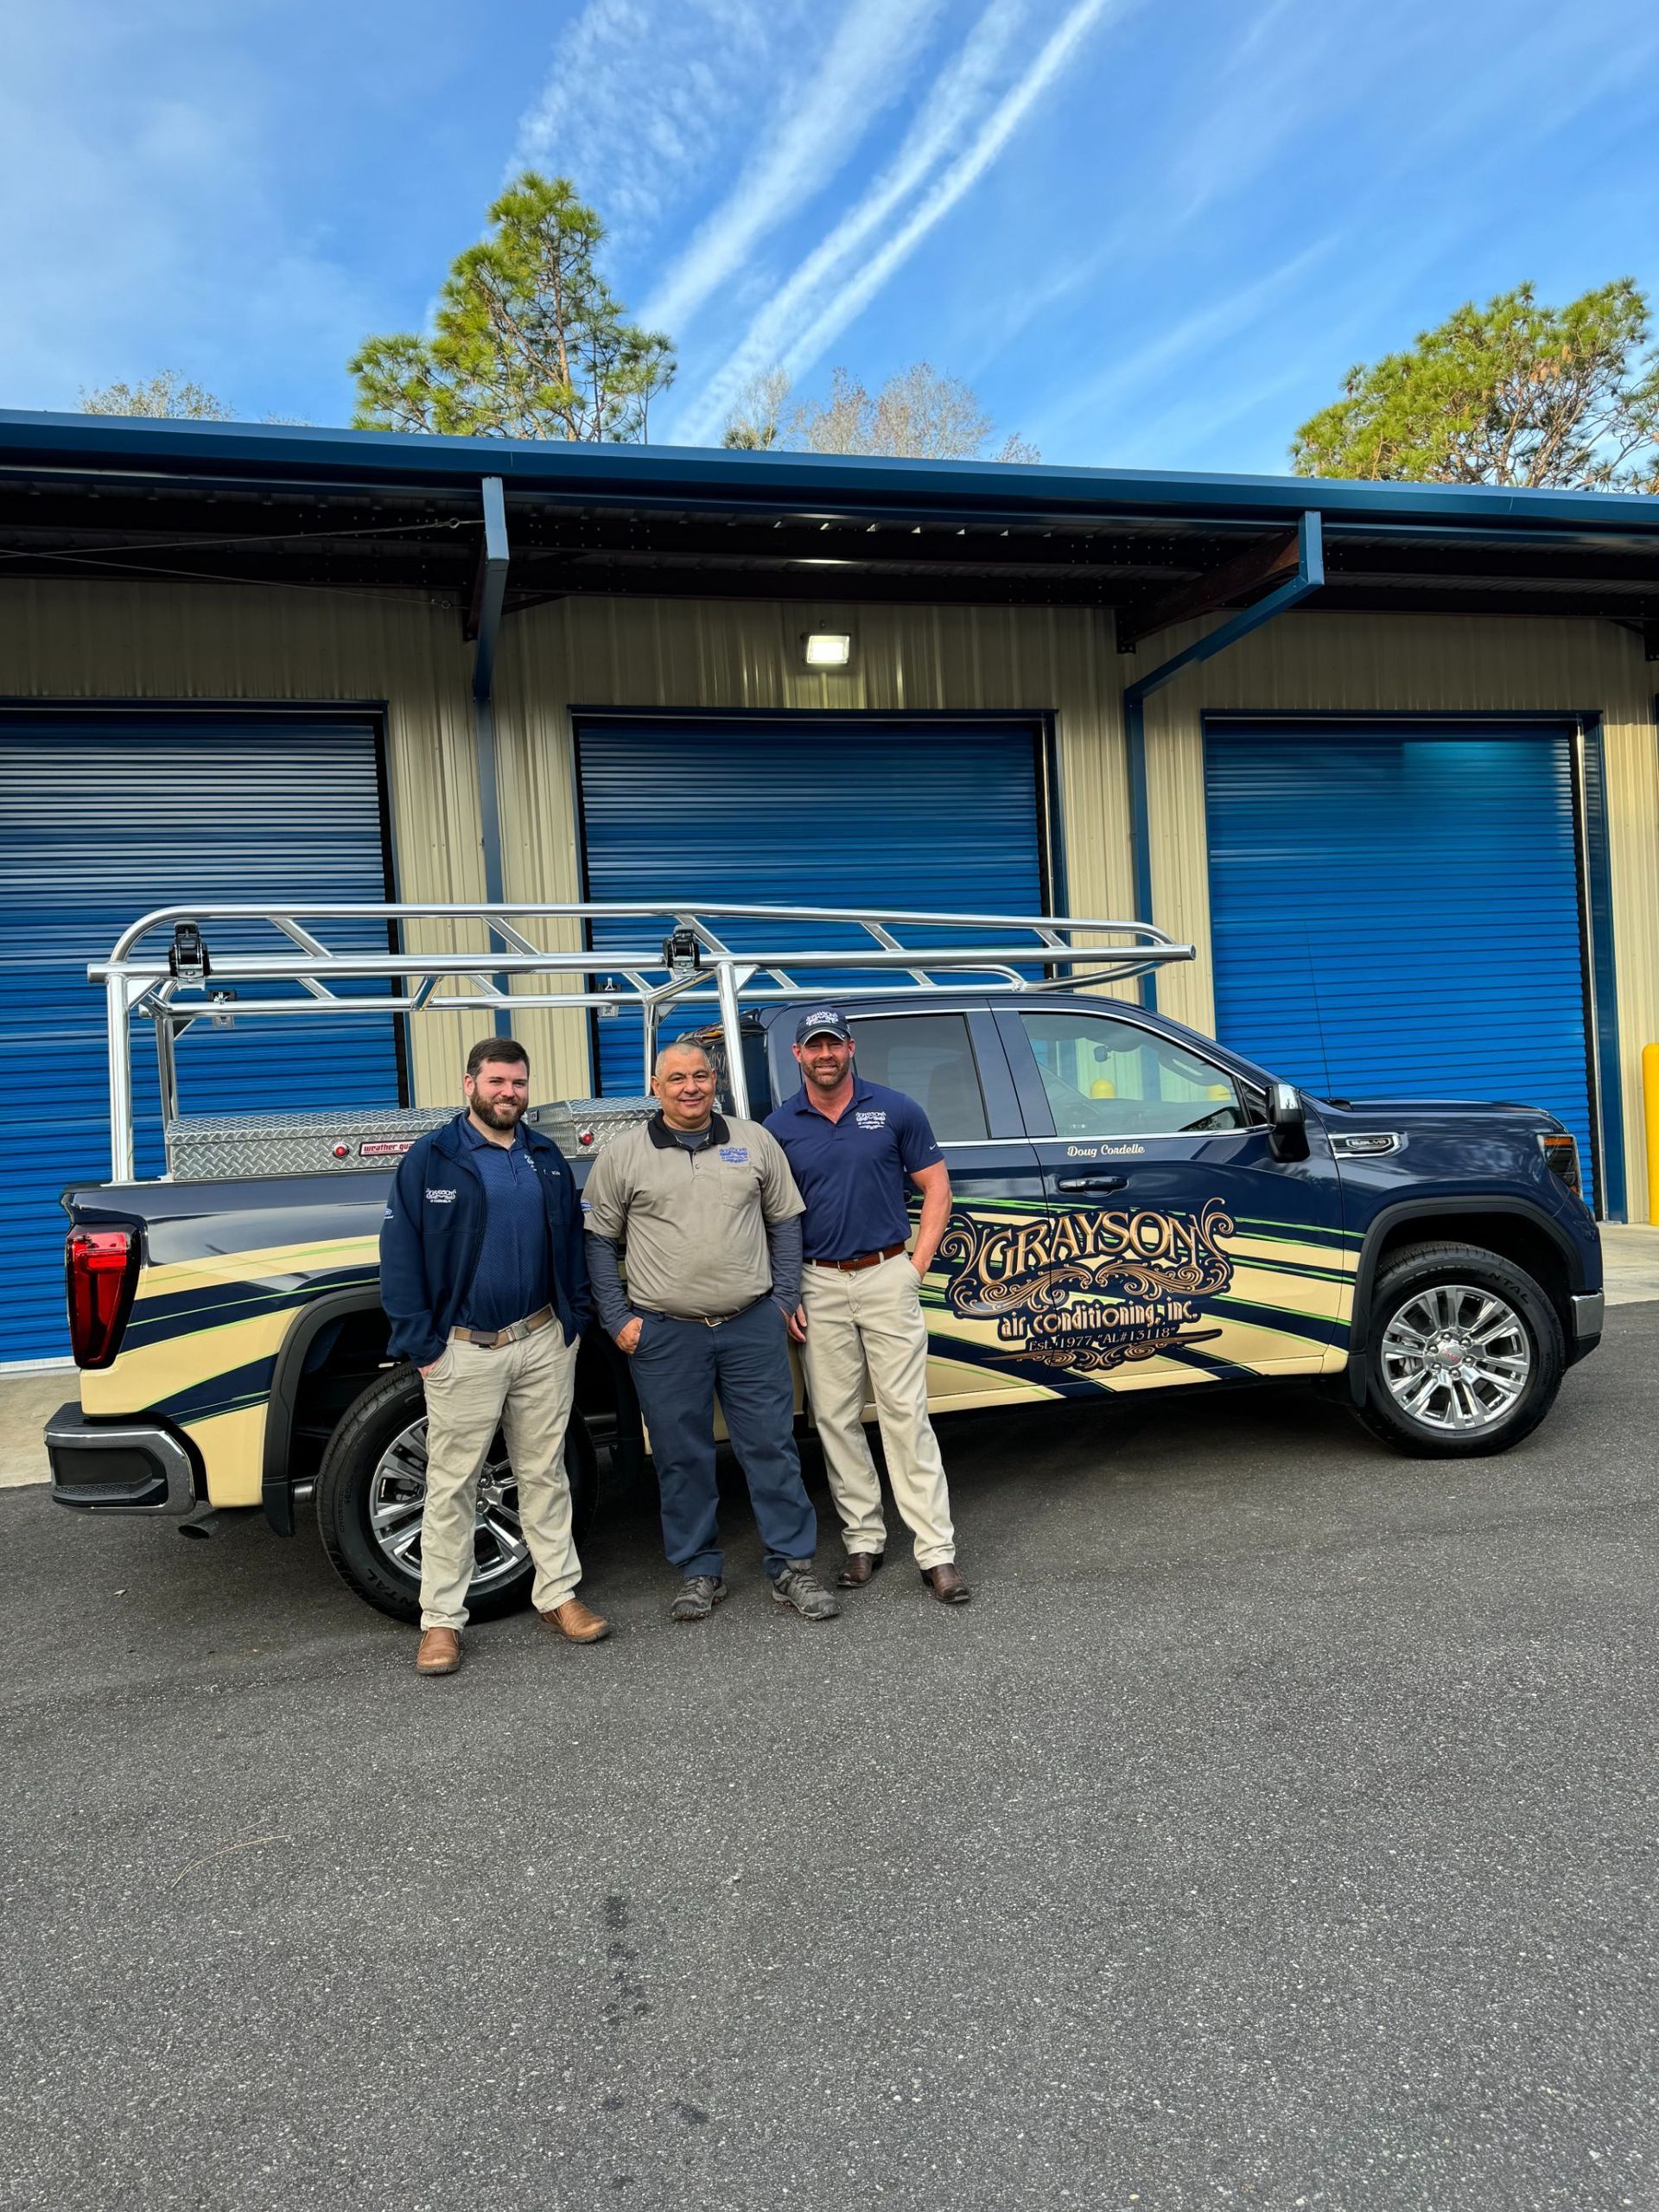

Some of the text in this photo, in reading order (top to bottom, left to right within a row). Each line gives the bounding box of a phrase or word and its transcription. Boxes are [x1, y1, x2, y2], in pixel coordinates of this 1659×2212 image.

[364, 1143, 397, 1152] weather
[1067, 1145, 1097, 1158] Doug
[977, 1211, 1199, 1285] GRAYSON
[1001, 1311, 1027, 1338] air
[1166, 1296, 1198, 1321] inc.
[1028, 1339, 1052, 1351] Est.
[1059, 1336, 1092, 1348] 1977
